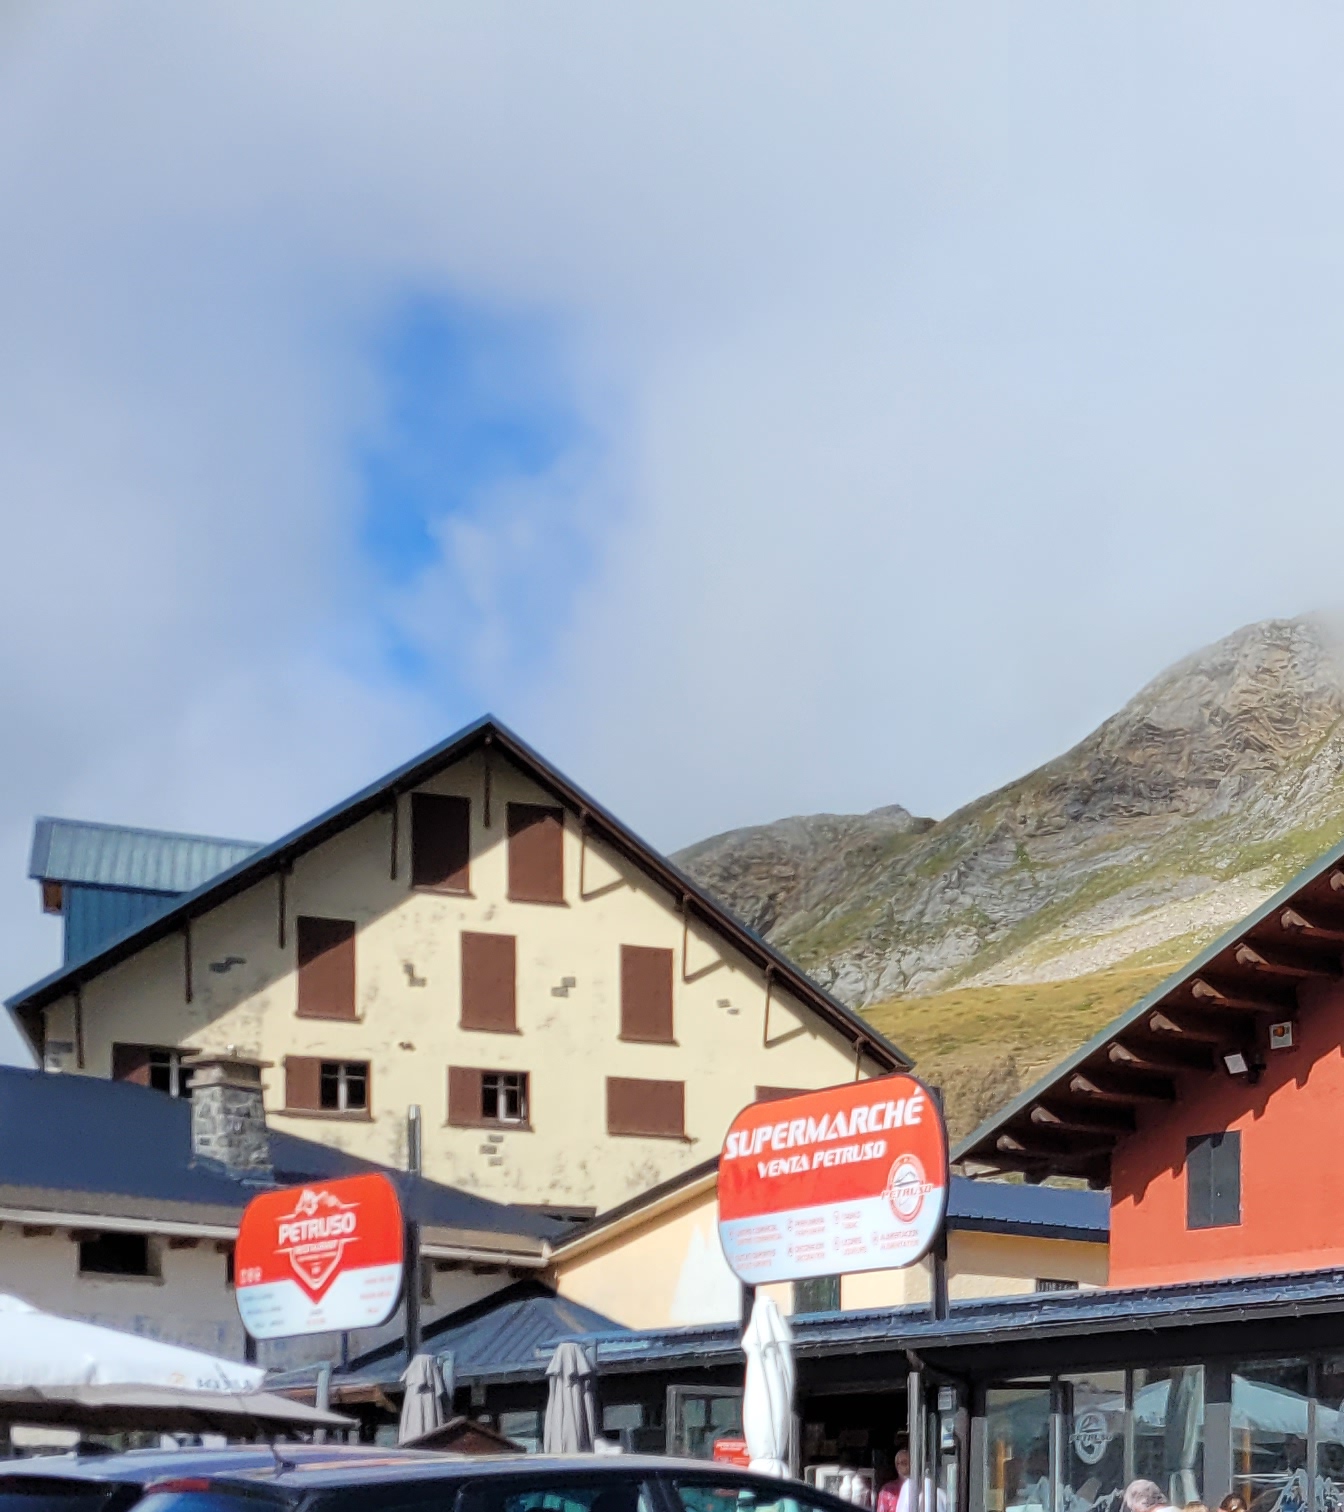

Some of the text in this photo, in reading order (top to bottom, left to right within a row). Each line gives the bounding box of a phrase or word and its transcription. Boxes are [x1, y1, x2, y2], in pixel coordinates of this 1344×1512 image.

[723, 1086, 925, 1160] SUPERMARCHÉ
[757, 1140, 887, 1179] VENTA PETRUSO
[881, 1183, 934, 1200] PETRUSO
[278, 1211, 357, 1246] PETRUSO
